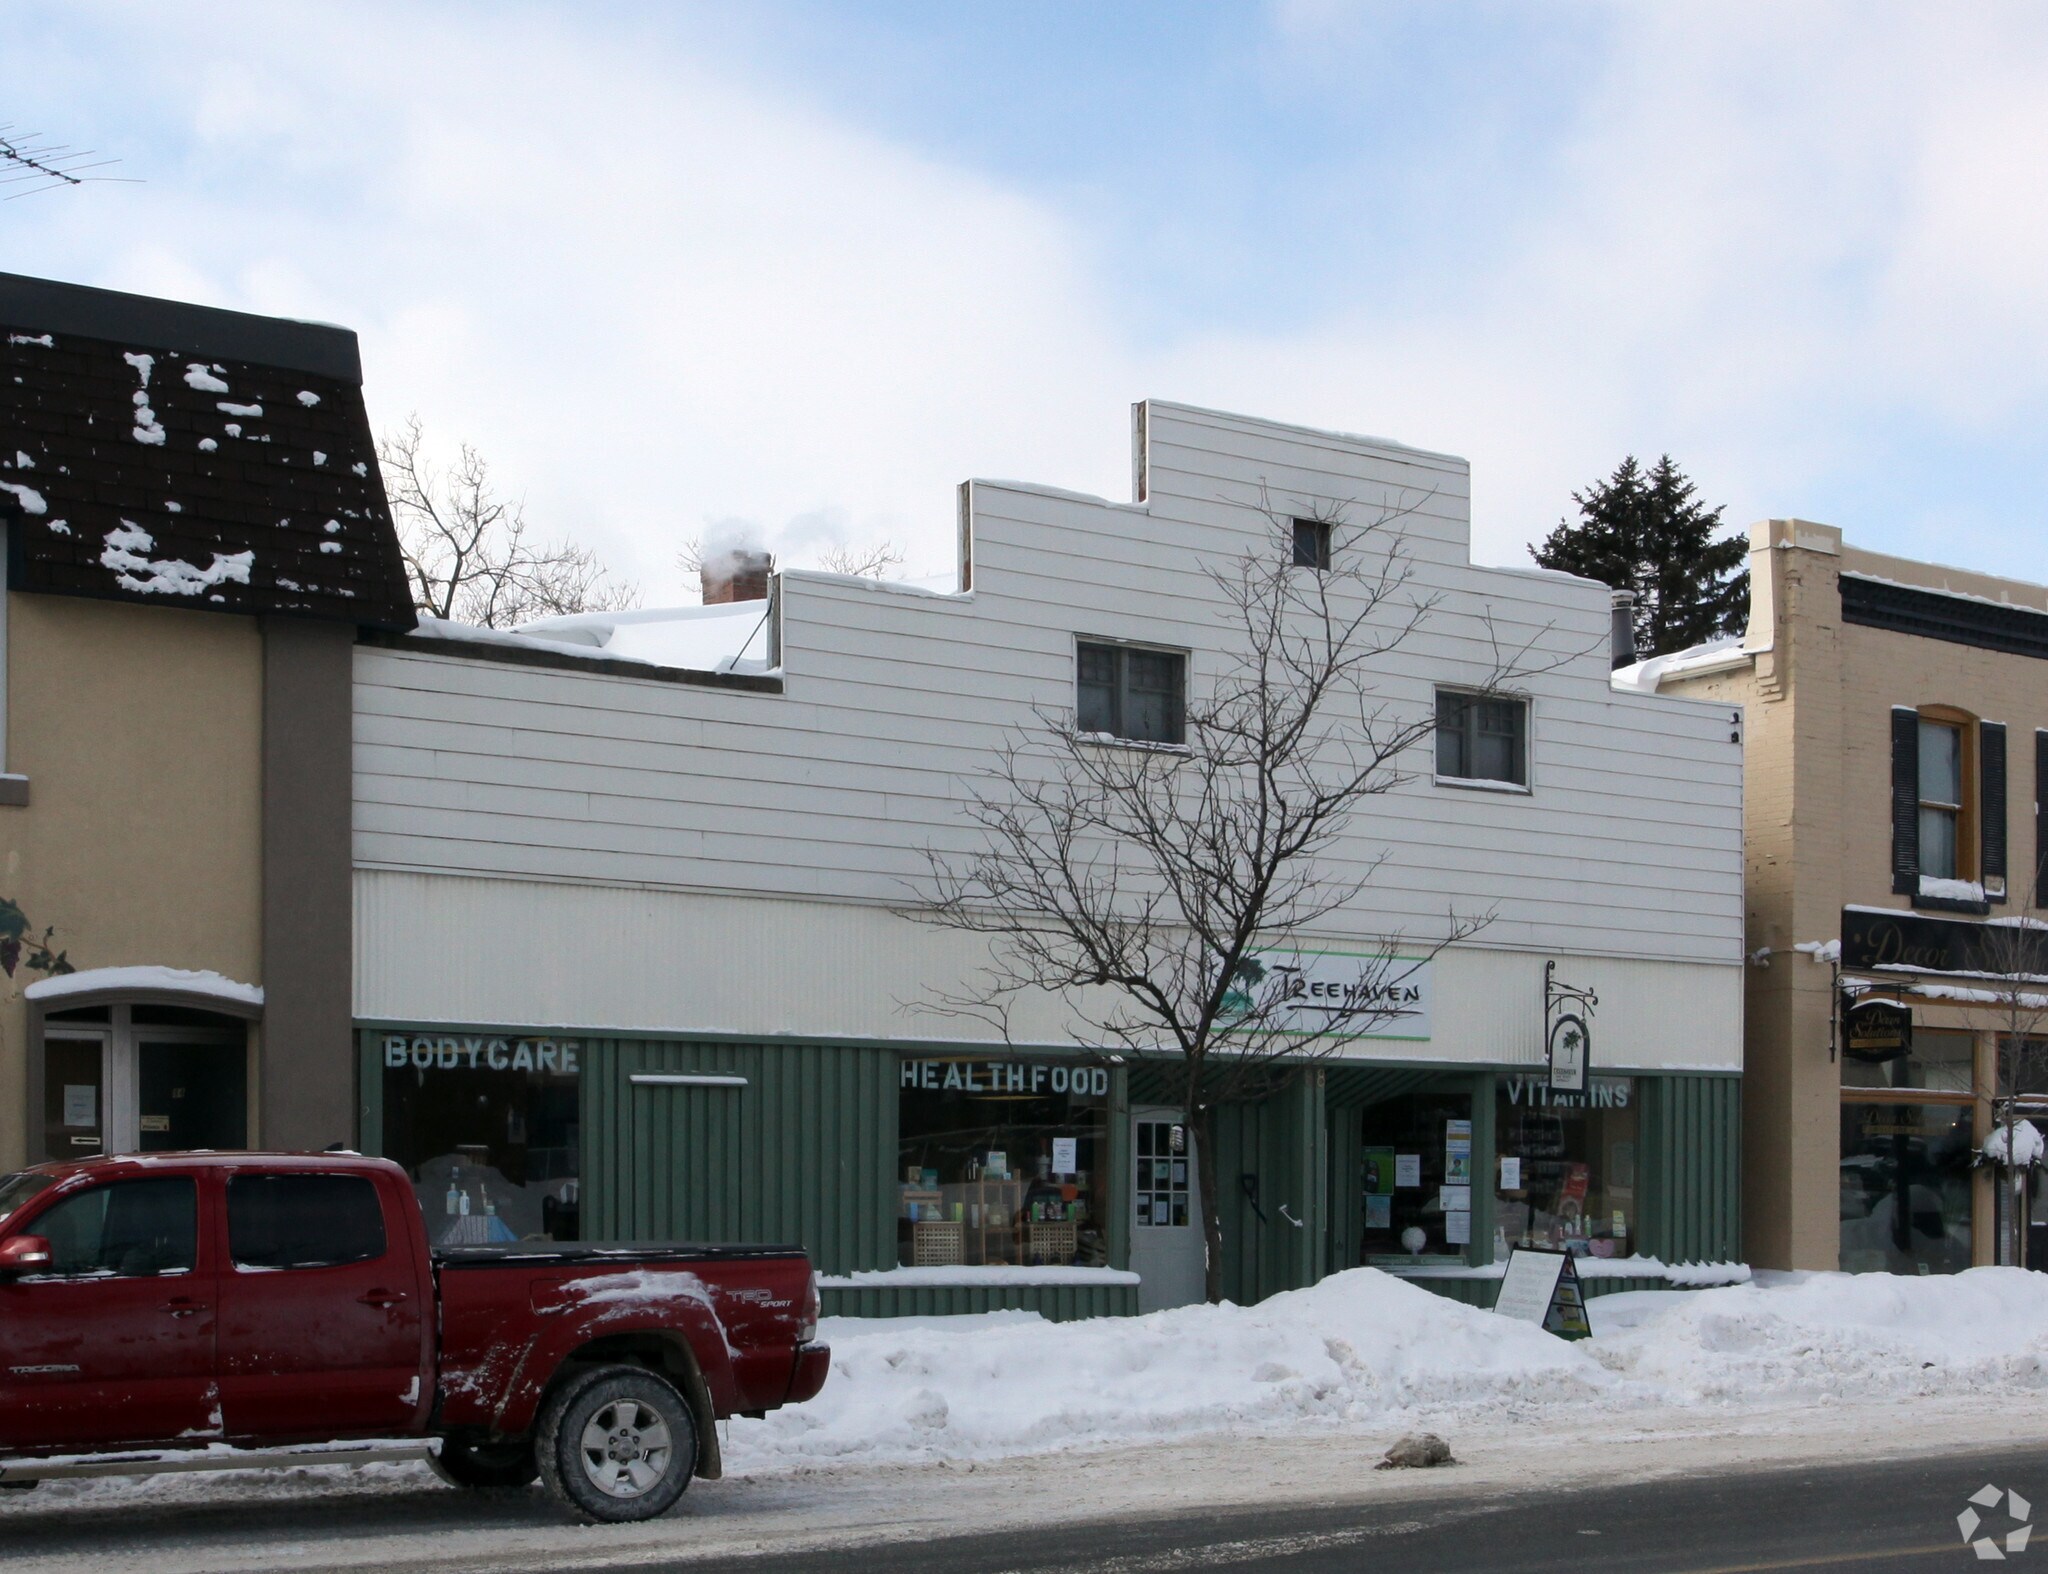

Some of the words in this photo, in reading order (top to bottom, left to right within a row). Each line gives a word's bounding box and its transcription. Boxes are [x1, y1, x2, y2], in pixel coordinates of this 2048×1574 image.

[1862, 920, 1949, 967] Decor
[1272, 965, 1420, 1002] TREEHAVEN
[384, 1035, 580, 1073] BODYCARE
[725, 1288, 773, 1304] TRD
[759, 1300, 793, 1308] SPORT
